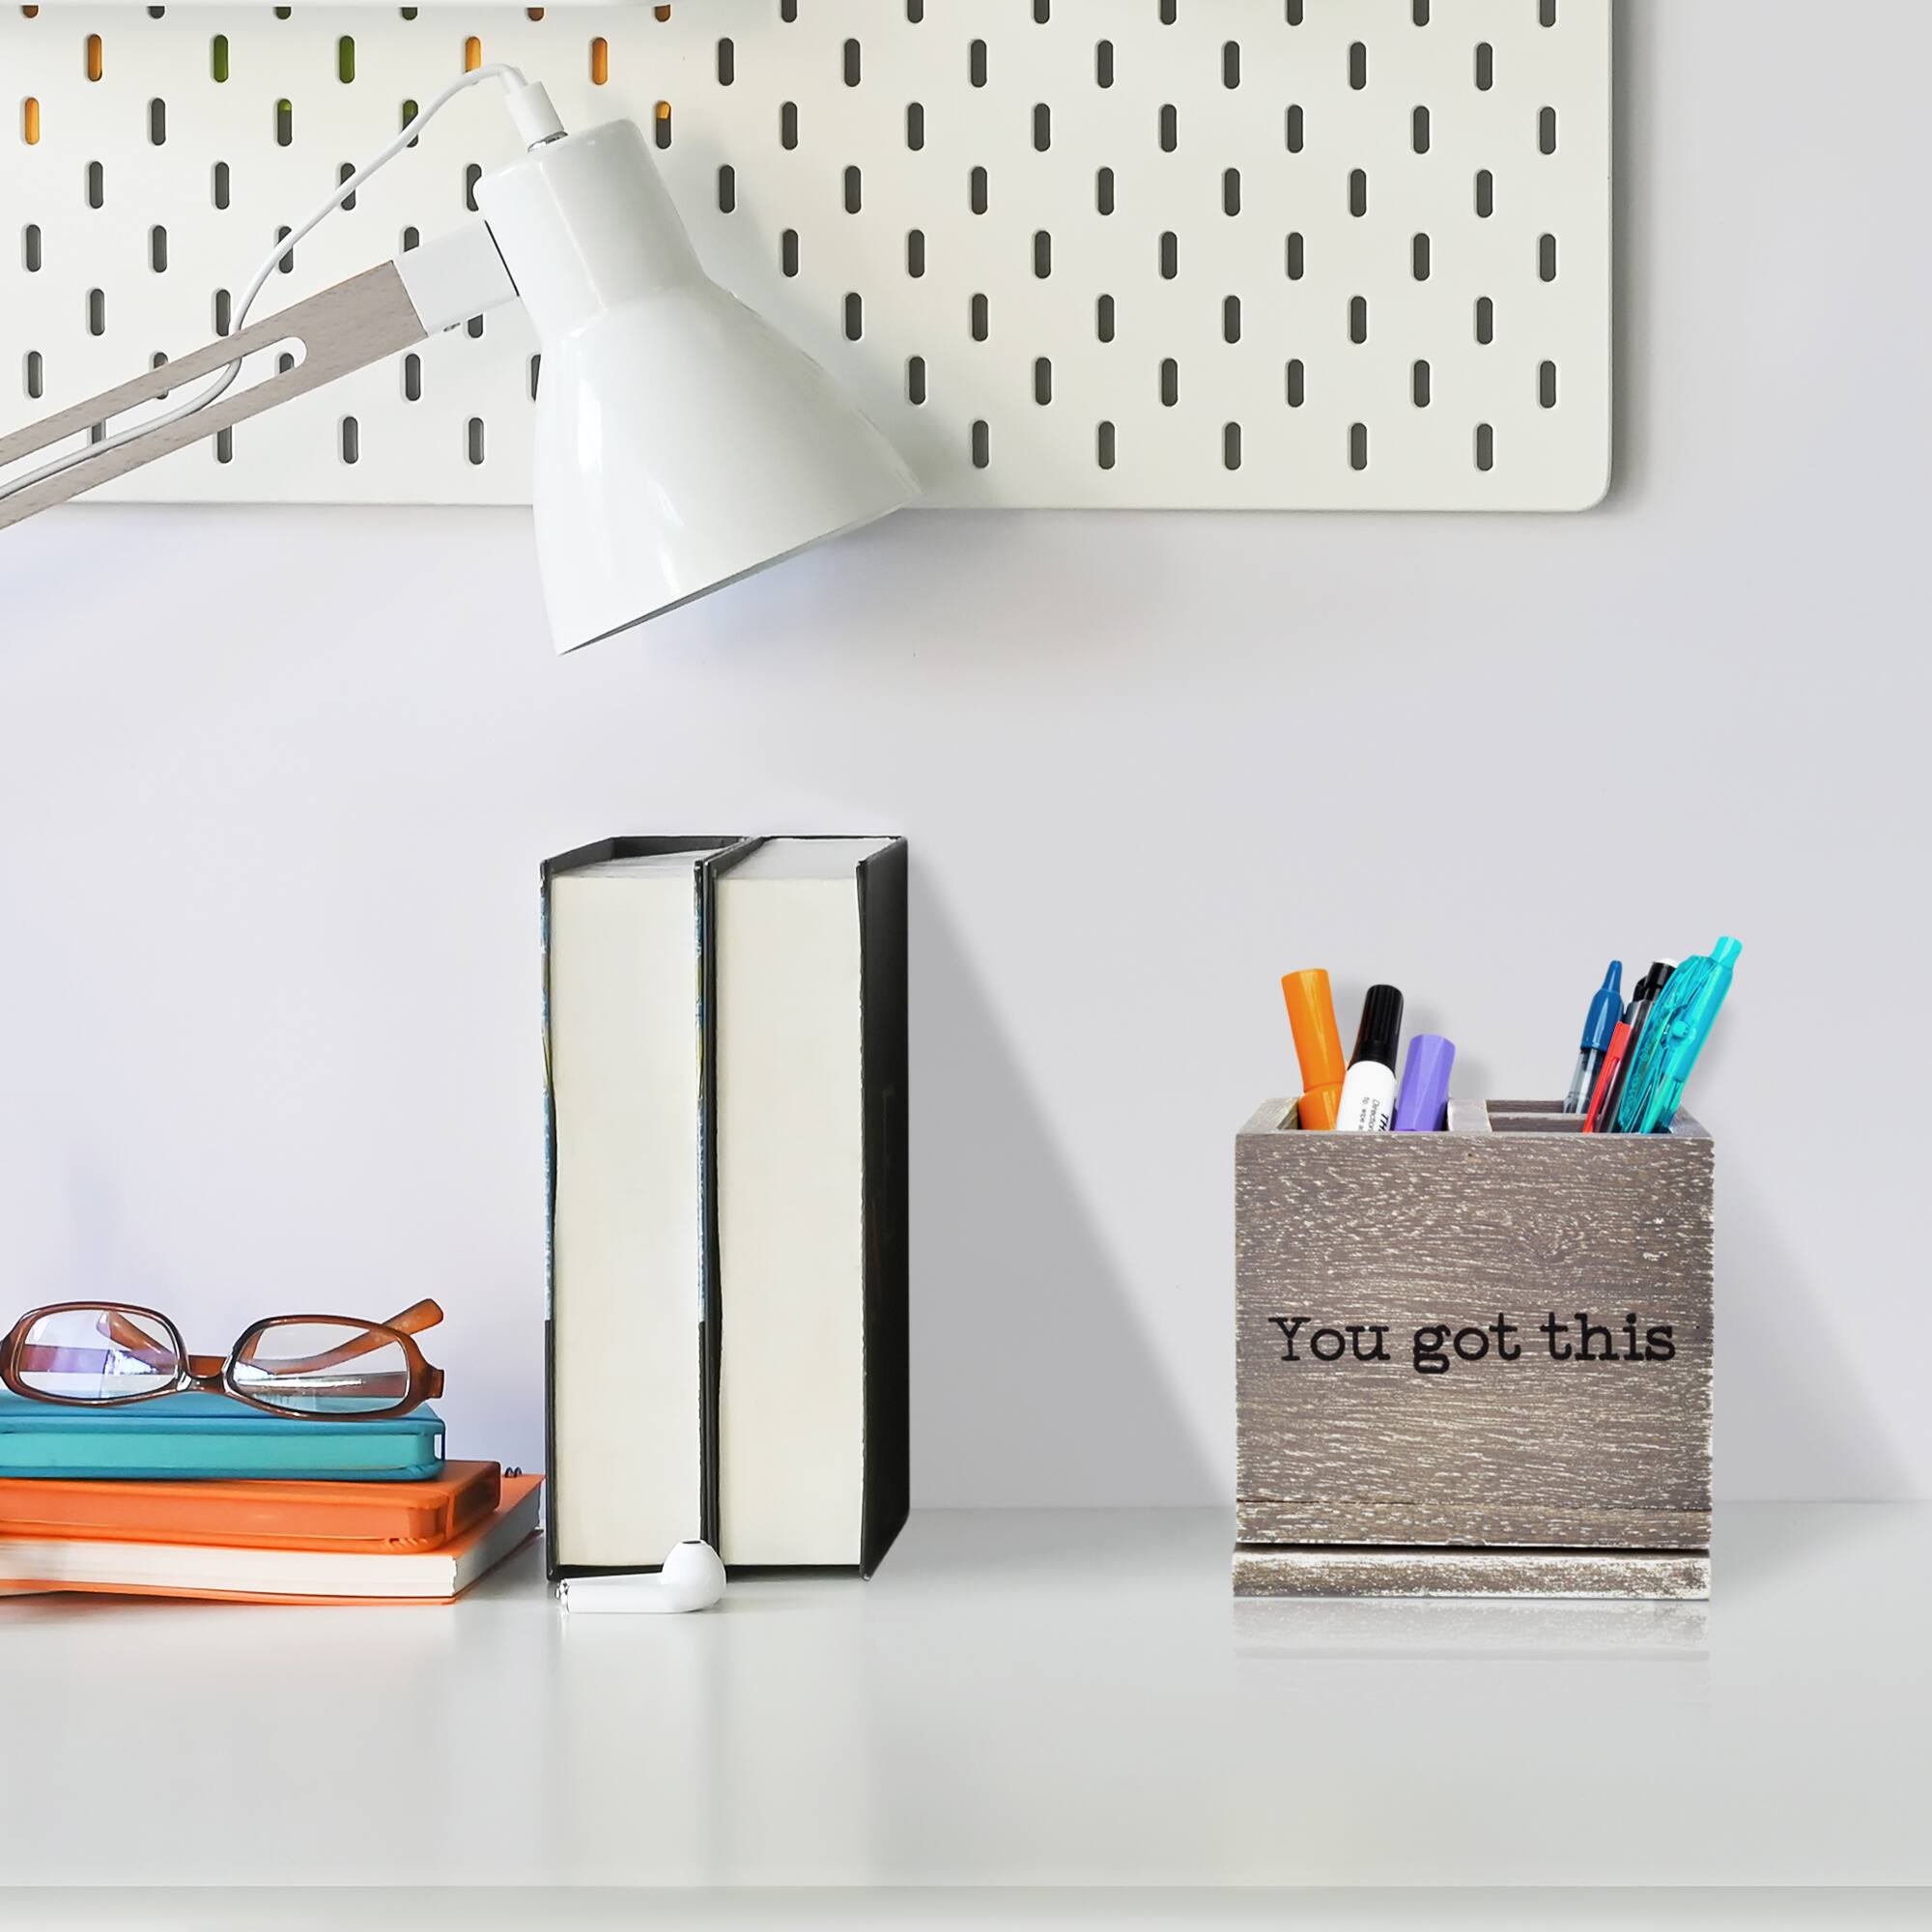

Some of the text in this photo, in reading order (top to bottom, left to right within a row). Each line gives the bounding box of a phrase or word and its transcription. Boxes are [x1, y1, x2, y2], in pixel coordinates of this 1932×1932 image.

[1378, 1113, 1389, 1131] TH
[1268, 1312, 1676, 1374] You got this
